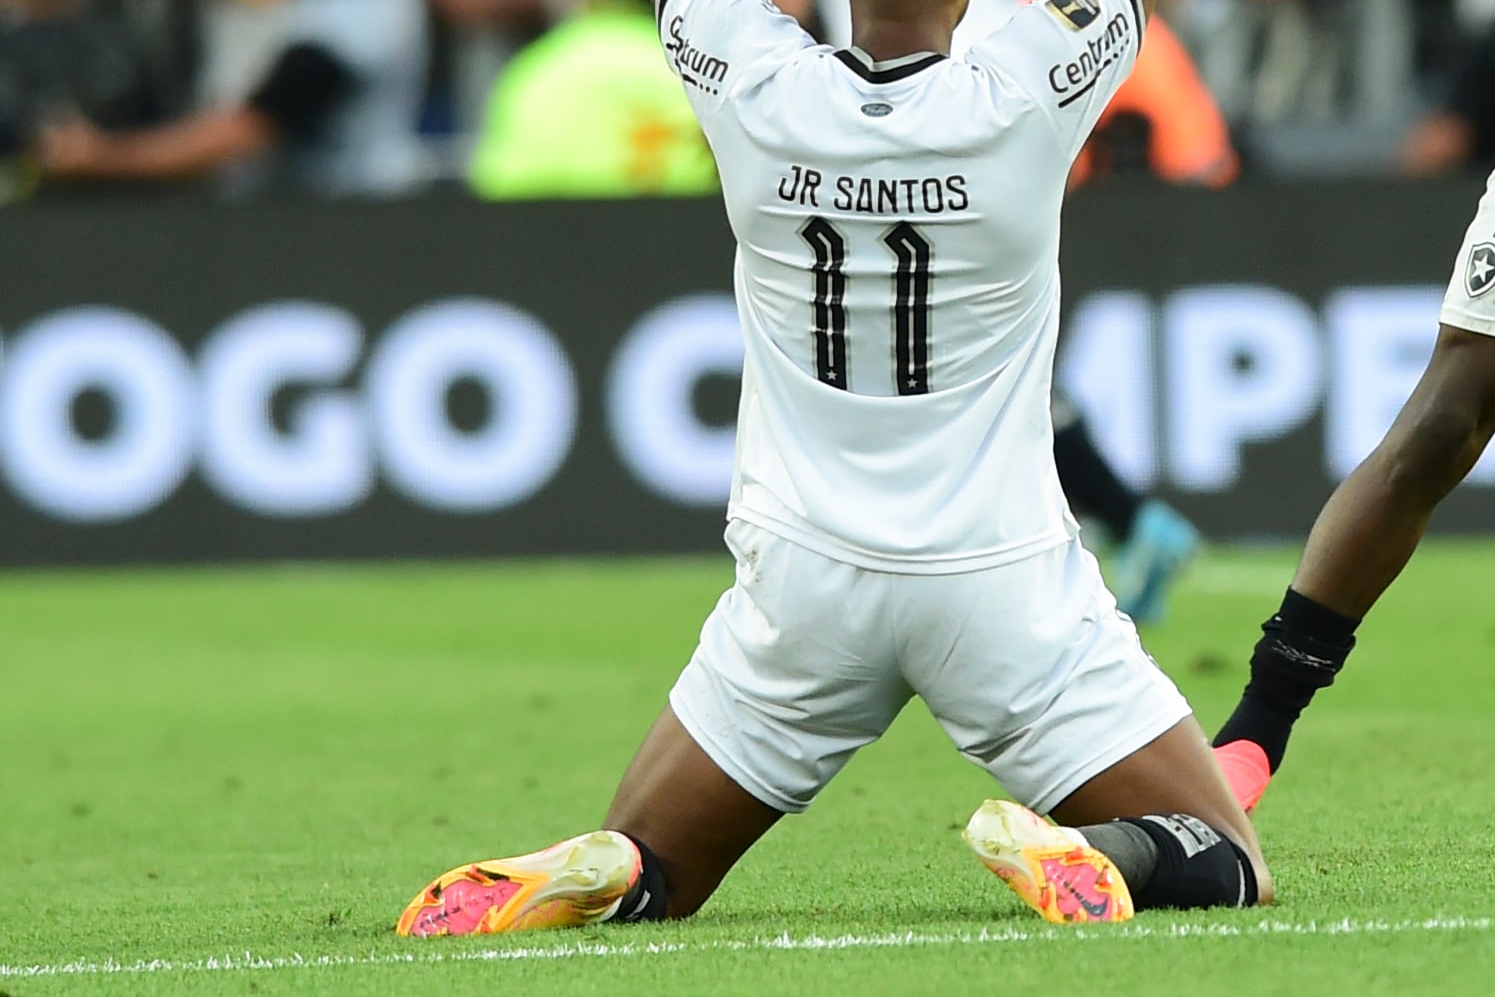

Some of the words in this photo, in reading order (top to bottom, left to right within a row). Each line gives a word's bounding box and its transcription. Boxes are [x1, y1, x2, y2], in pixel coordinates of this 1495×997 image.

[778, 165, 821, 207] JR
[833, 175, 968, 214] SANTOS
[798, 215, 934, 396] 11
[0, 294, 580, 524] OGO
